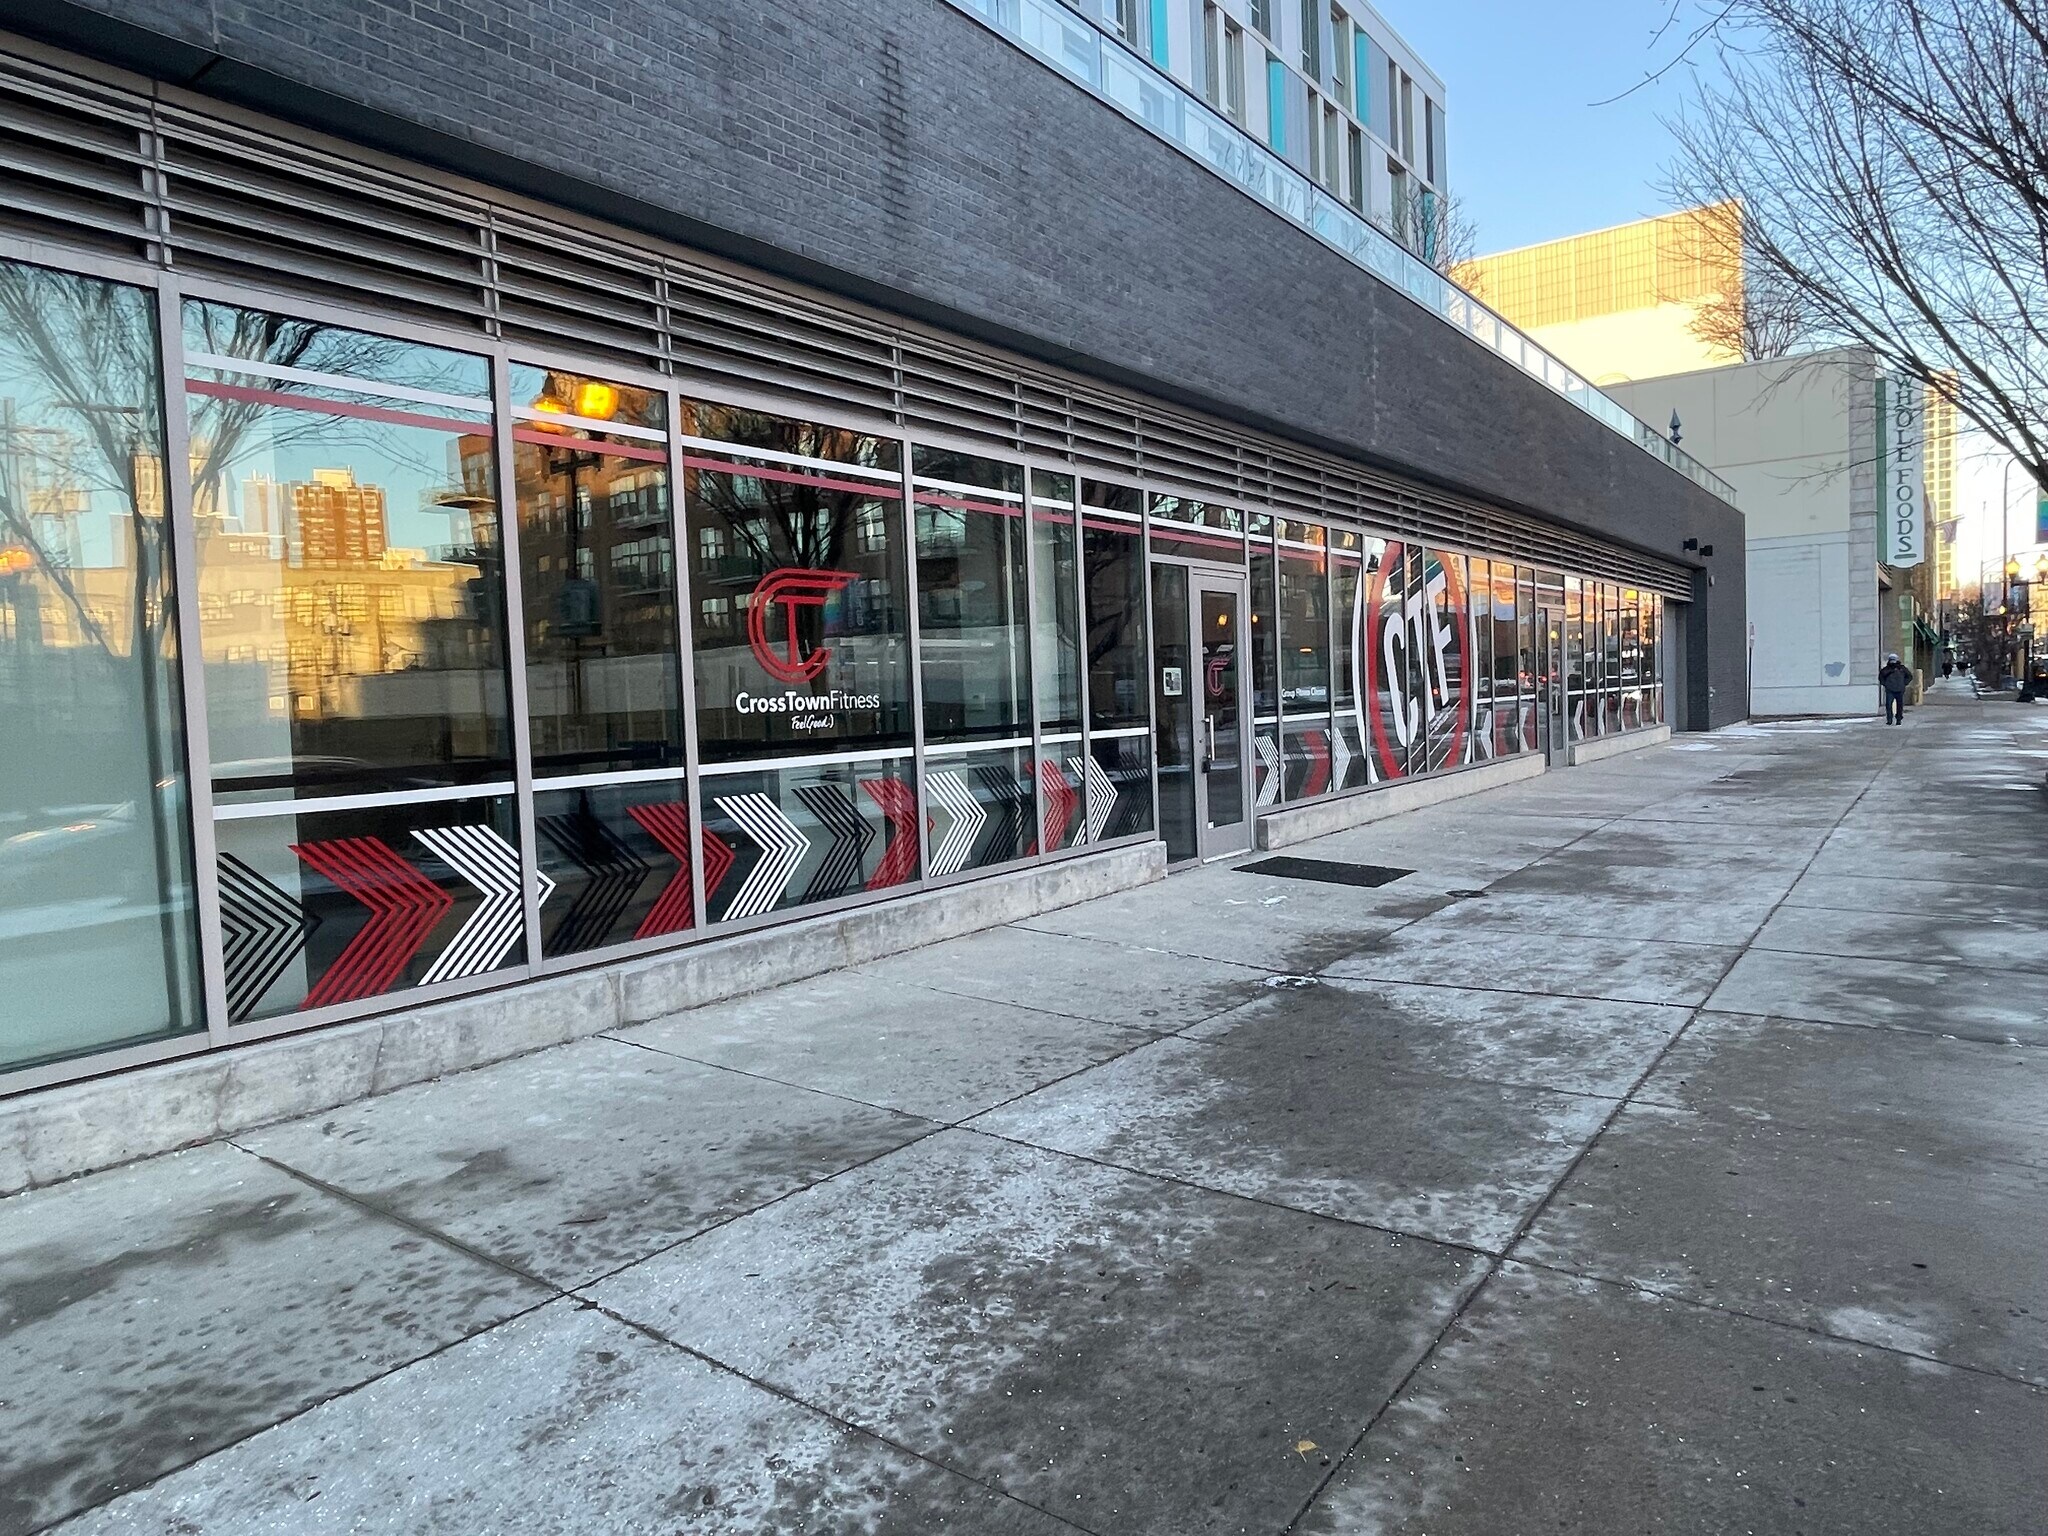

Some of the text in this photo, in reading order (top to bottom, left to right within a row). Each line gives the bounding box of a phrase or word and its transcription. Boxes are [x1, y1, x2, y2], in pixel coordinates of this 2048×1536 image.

[1895, 374, 1914, 553] WHOLE FOODS
[735, 690, 880, 714] CrossTownFitness
[1384, 570, 1452, 747] CTF
